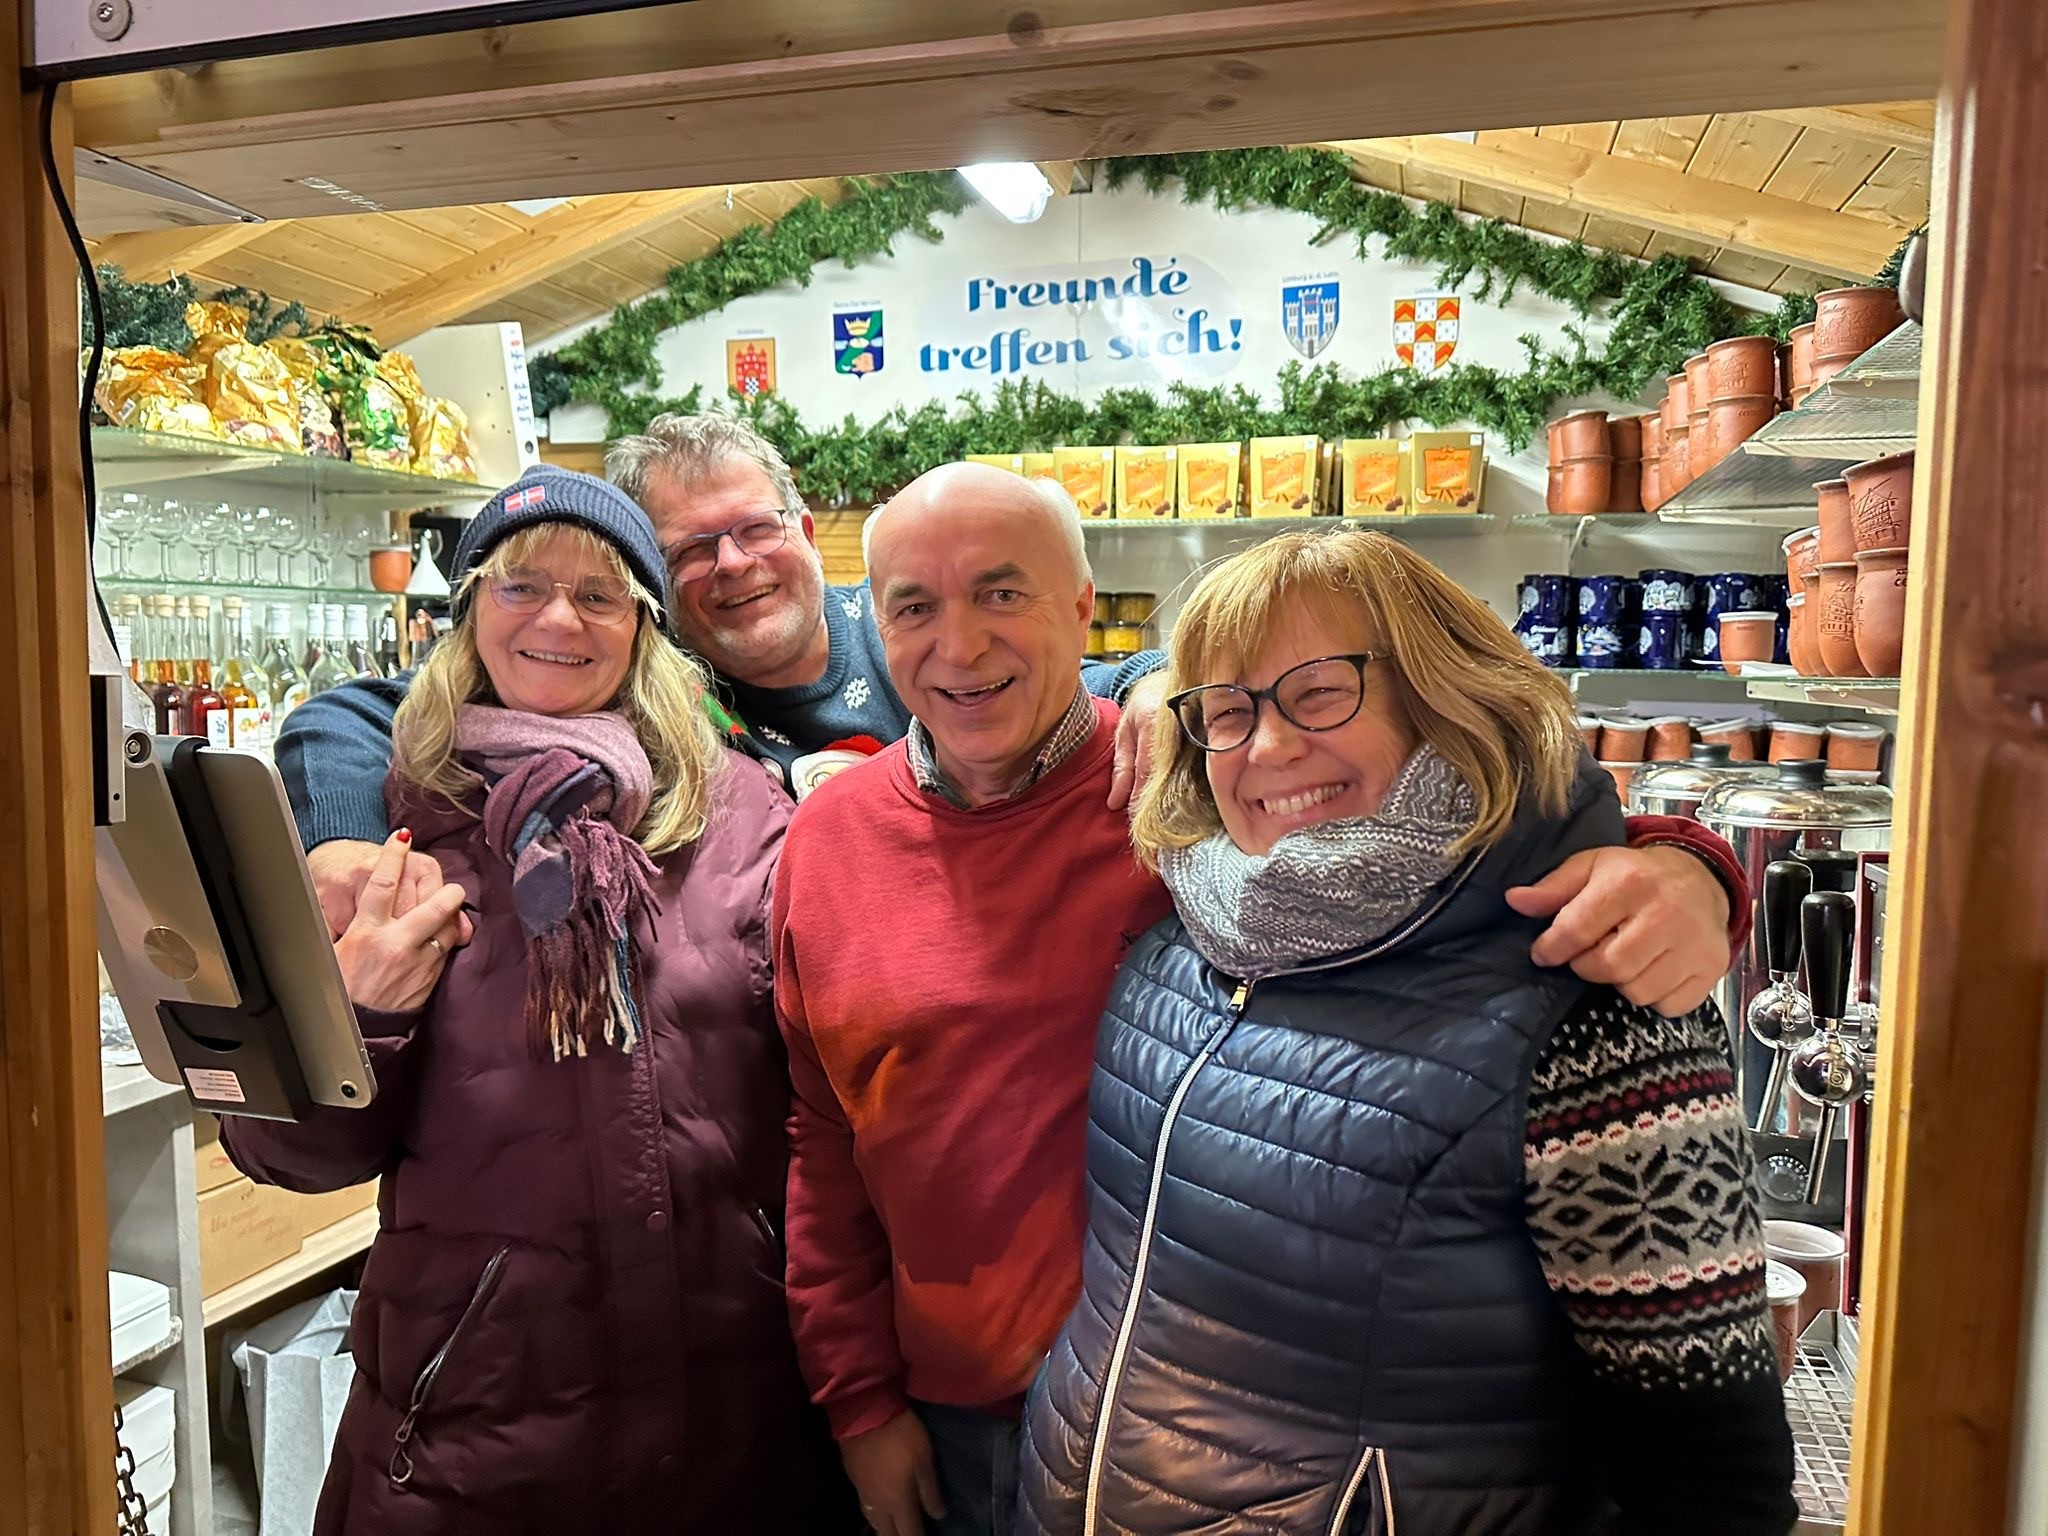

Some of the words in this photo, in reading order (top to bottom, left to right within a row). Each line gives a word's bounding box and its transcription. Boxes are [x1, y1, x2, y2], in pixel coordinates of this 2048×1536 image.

[968, 256, 1192, 312] Freunde
[919, 327, 1094, 375] treffen
[1107, 307, 1243, 361] sich!
